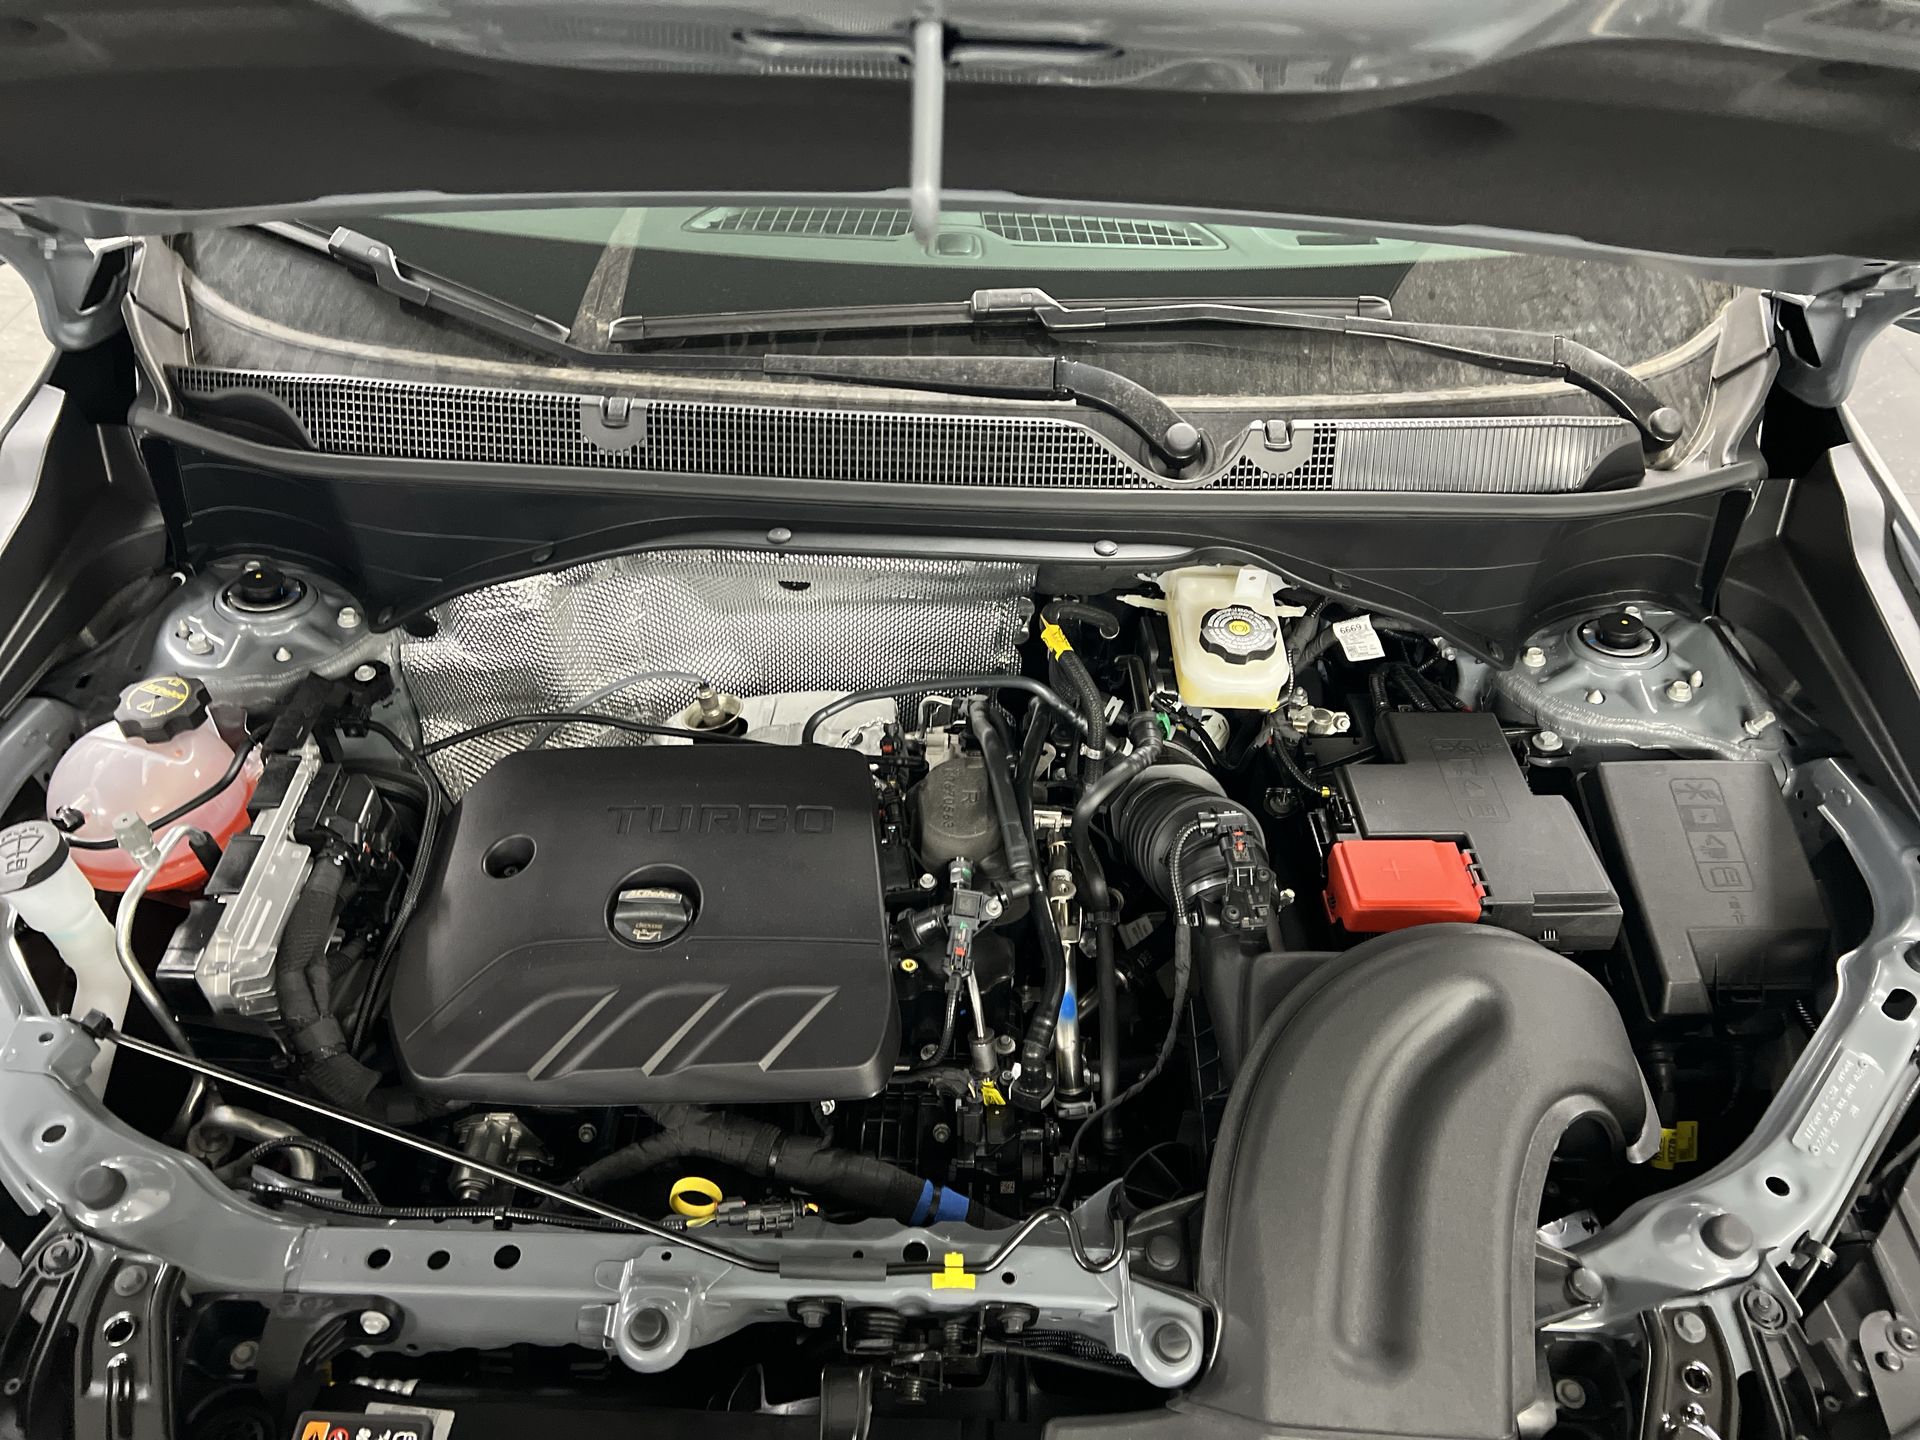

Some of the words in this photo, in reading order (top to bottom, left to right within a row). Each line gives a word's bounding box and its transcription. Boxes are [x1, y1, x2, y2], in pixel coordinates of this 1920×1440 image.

[1339, 623, 1362, 635] 6669
[960, 788, 978, 803] R
[607, 804, 835, 834] TURBO
